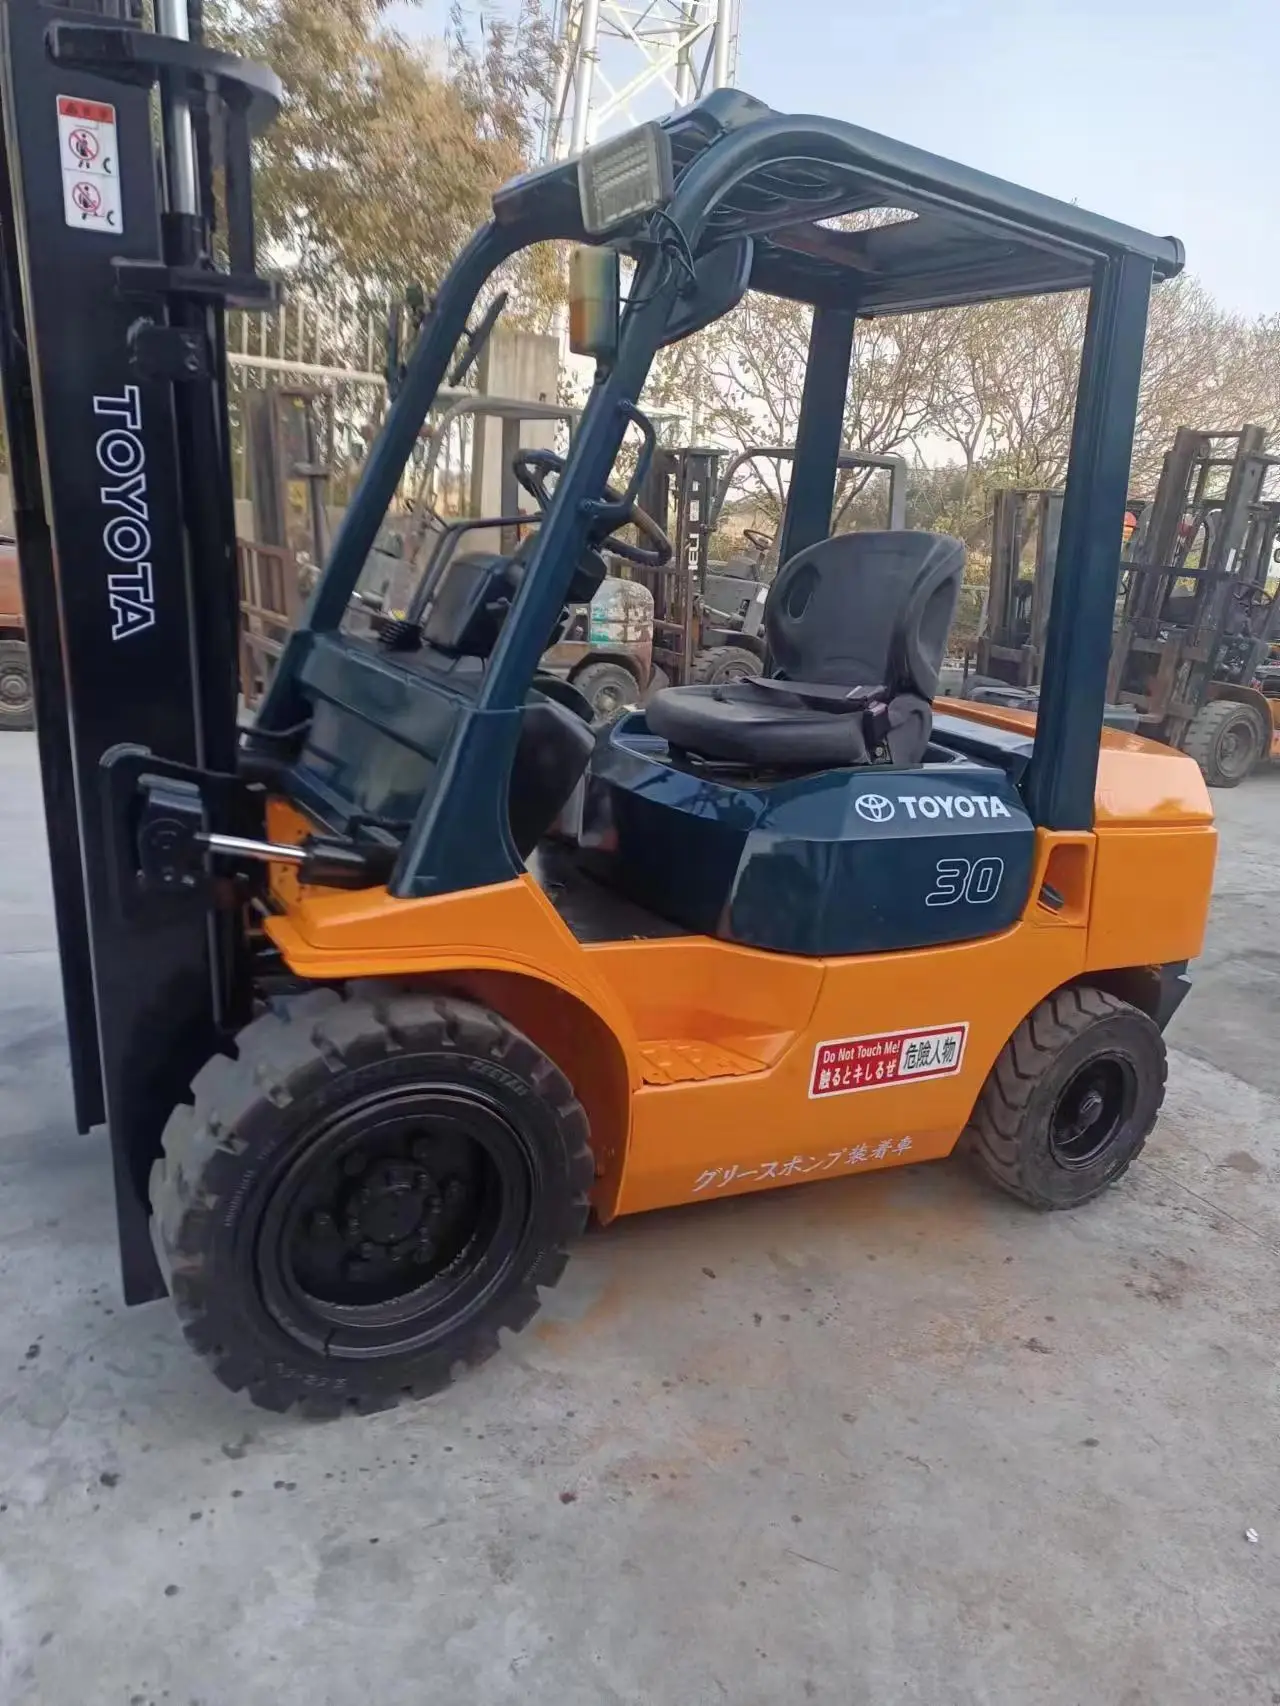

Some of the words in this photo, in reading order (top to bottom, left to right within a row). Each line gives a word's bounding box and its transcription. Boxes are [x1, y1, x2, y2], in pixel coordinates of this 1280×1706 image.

[93, 385, 156, 641] TOYOTA
[898, 796, 1012, 819] TOYOTA
[925, 857, 1004, 906] 30
[823, 1050, 835, 1063] Do
[838, 1049, 855, 1062] Not
[857, 1045, 882, 1059] Touch
[883, 1040, 901, 1055] Me!
